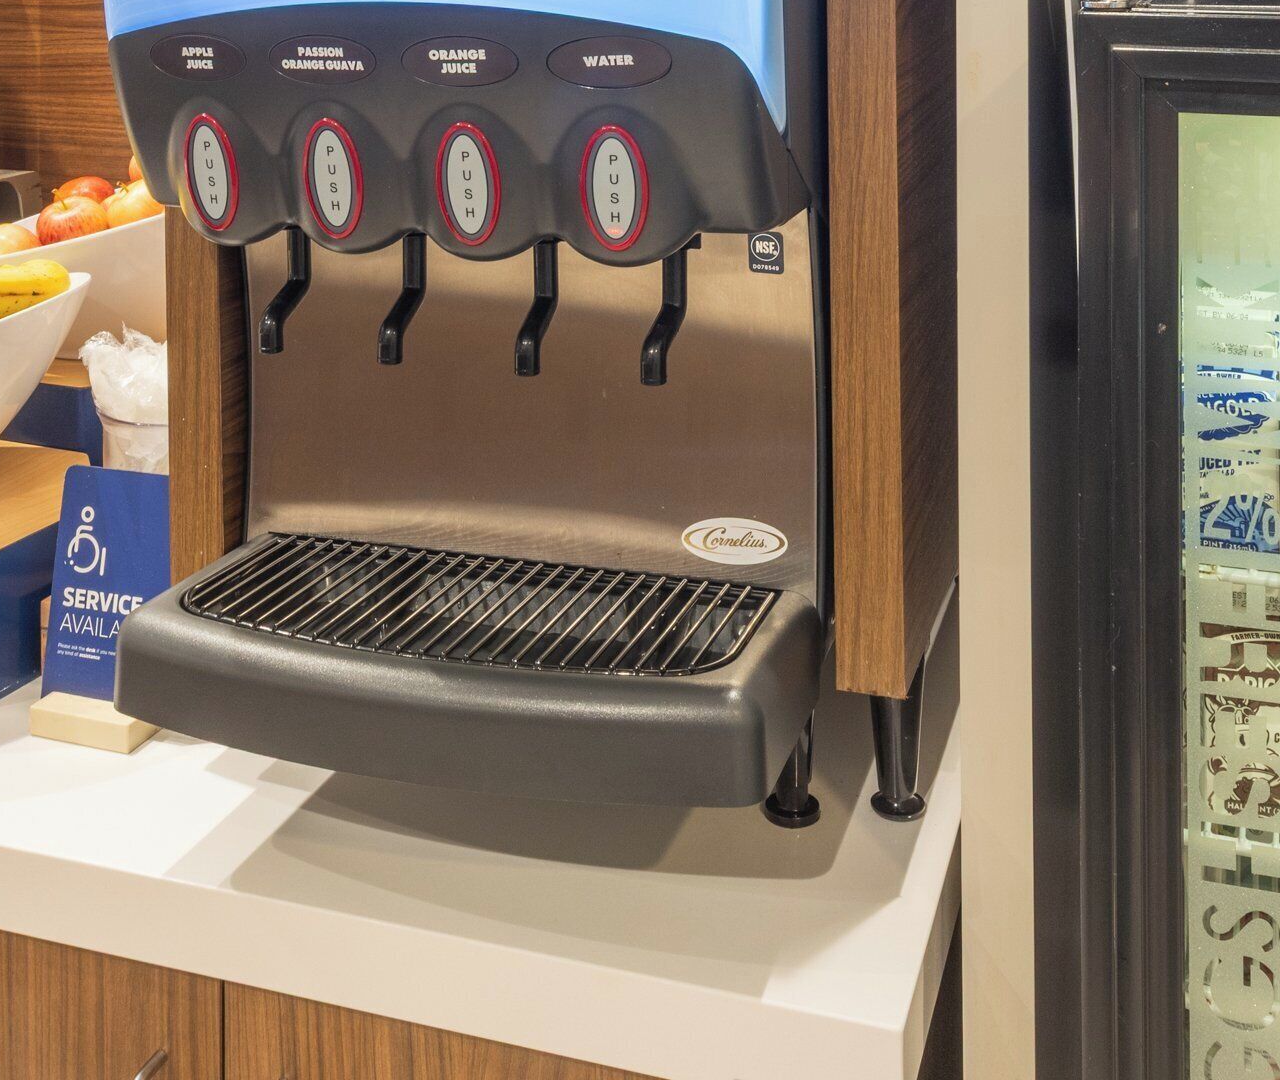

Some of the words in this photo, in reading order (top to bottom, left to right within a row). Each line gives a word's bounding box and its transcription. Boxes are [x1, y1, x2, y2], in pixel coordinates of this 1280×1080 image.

[181, 46, 215, 58] APPLE
[297, 46, 344, 58] PASSION
[428, 48, 487, 61] ORANGE
[185, 58, 214, 70] JUICE
[281, 58, 325, 70] ORANGE
[325, 59, 365, 72] GUAVA
[440, 61, 477, 75] JUICE
[582, 54, 635, 68] WATER
[203, 139, 219, 205] PUSH
[326, 145, 341, 212] PUSH
[461, 151, 476, 219] PUSH
[608, 153, 621, 223] PUSH
[755, 240, 775, 255] NSF
[702, 527, 765, 550] Cornelius
[1203, 539, 1224, 548] PINT
[62, 586, 144, 615] SERVICE
